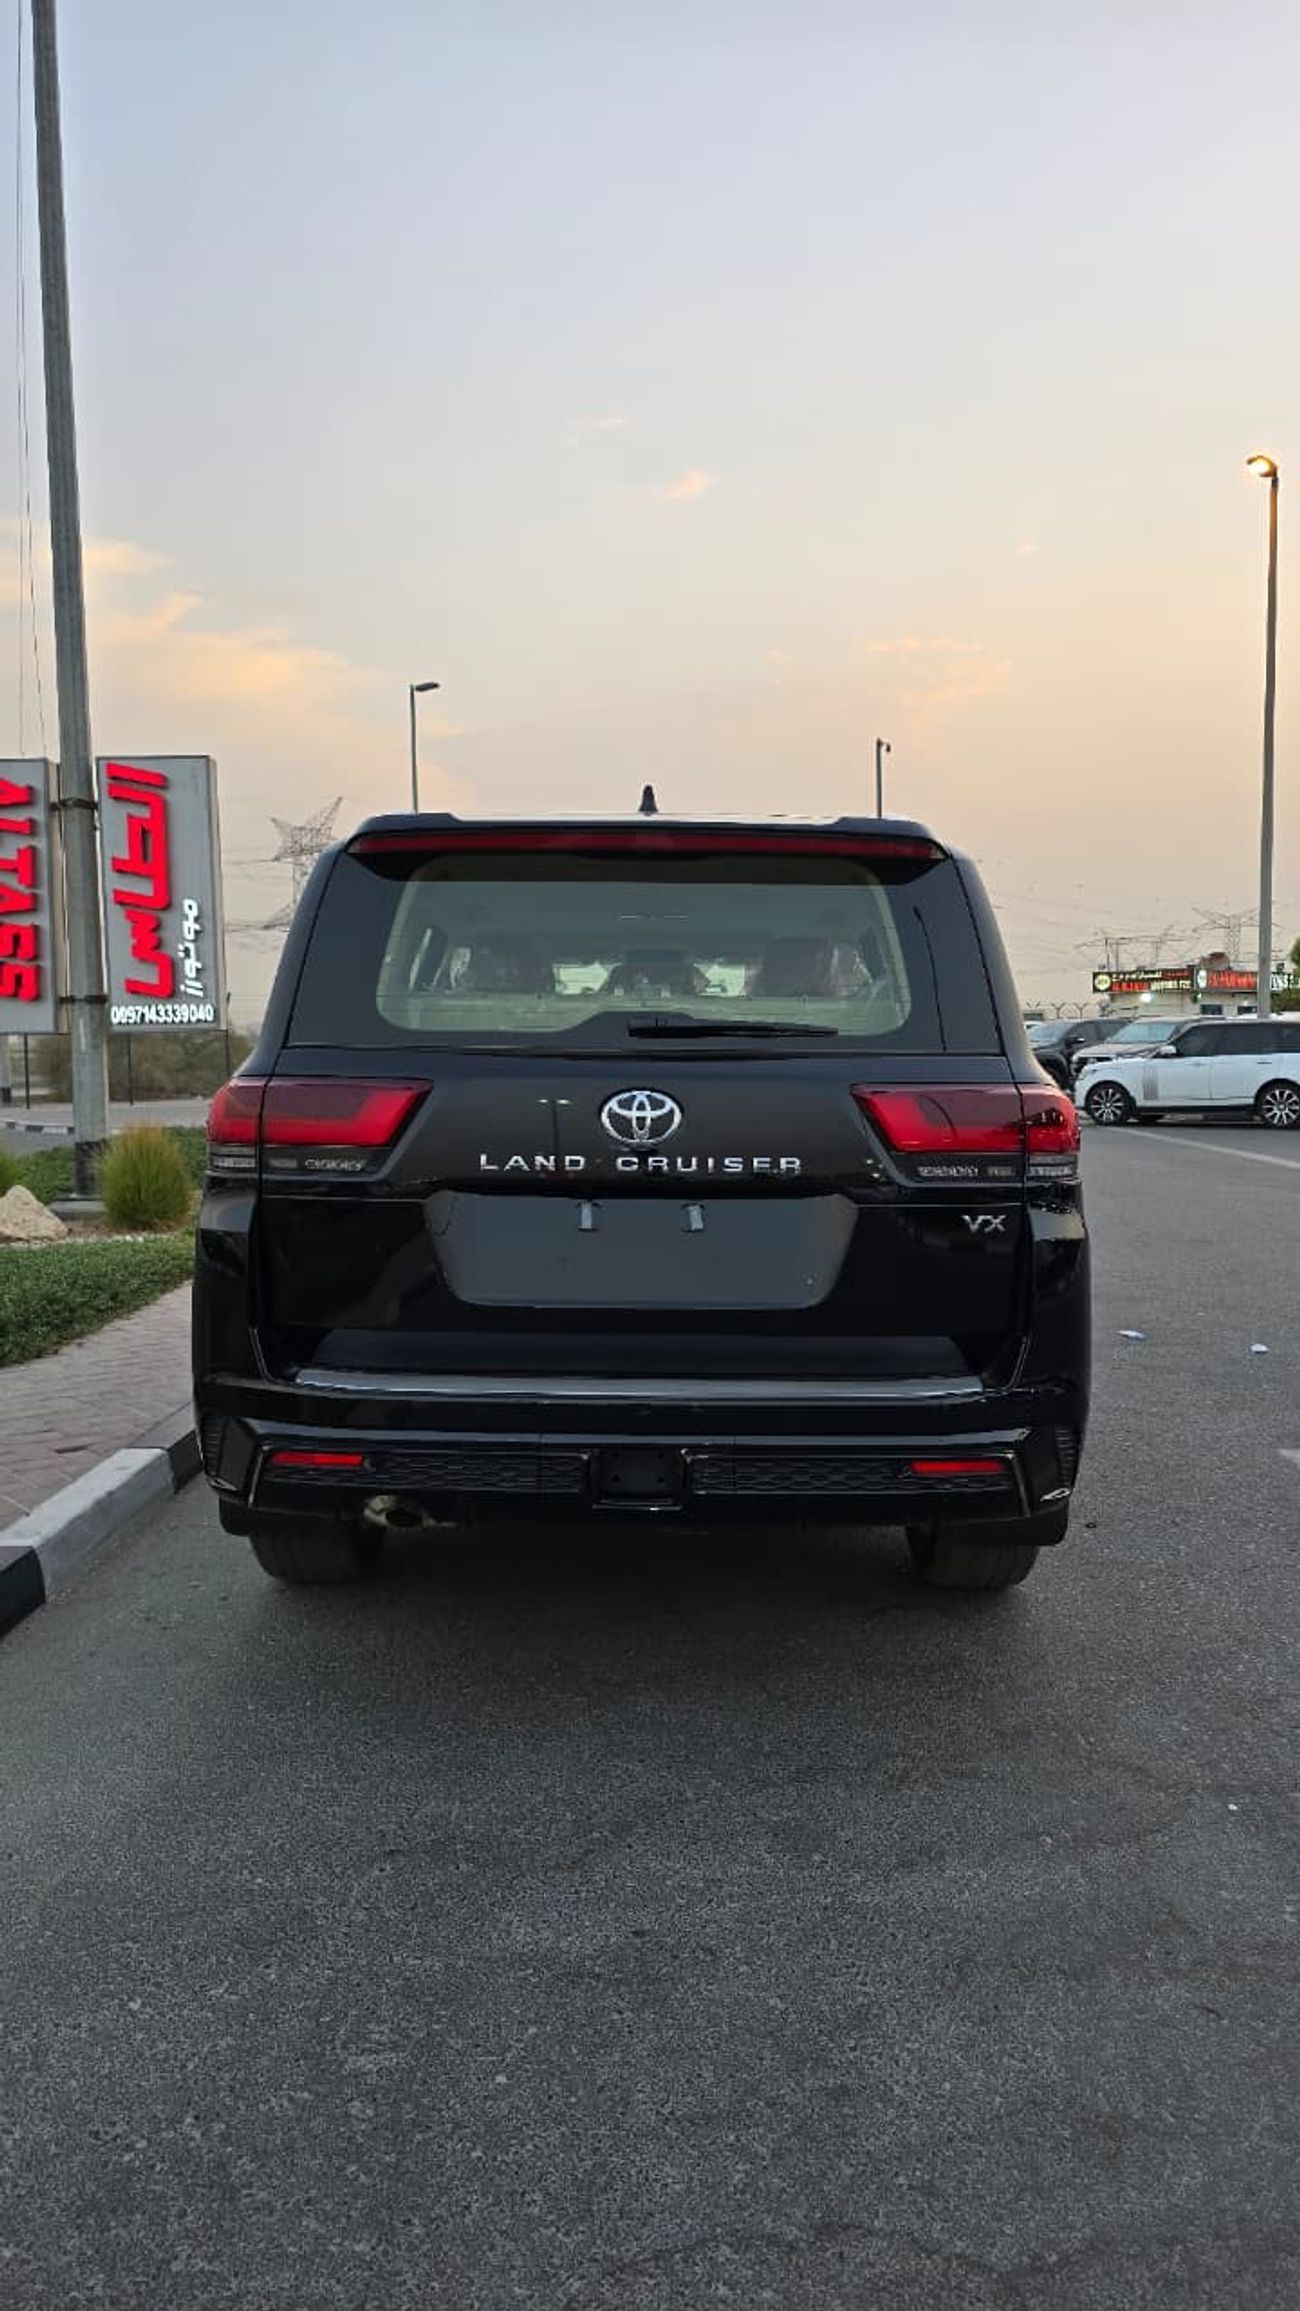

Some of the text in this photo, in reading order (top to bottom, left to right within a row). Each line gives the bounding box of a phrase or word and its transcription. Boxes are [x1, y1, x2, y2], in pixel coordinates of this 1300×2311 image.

[110, 1003, 215, 1025] 0097143339040
[479, 1153, 802, 1174] LAND CRUISER
[961, 1214, 1007, 1232] VX
